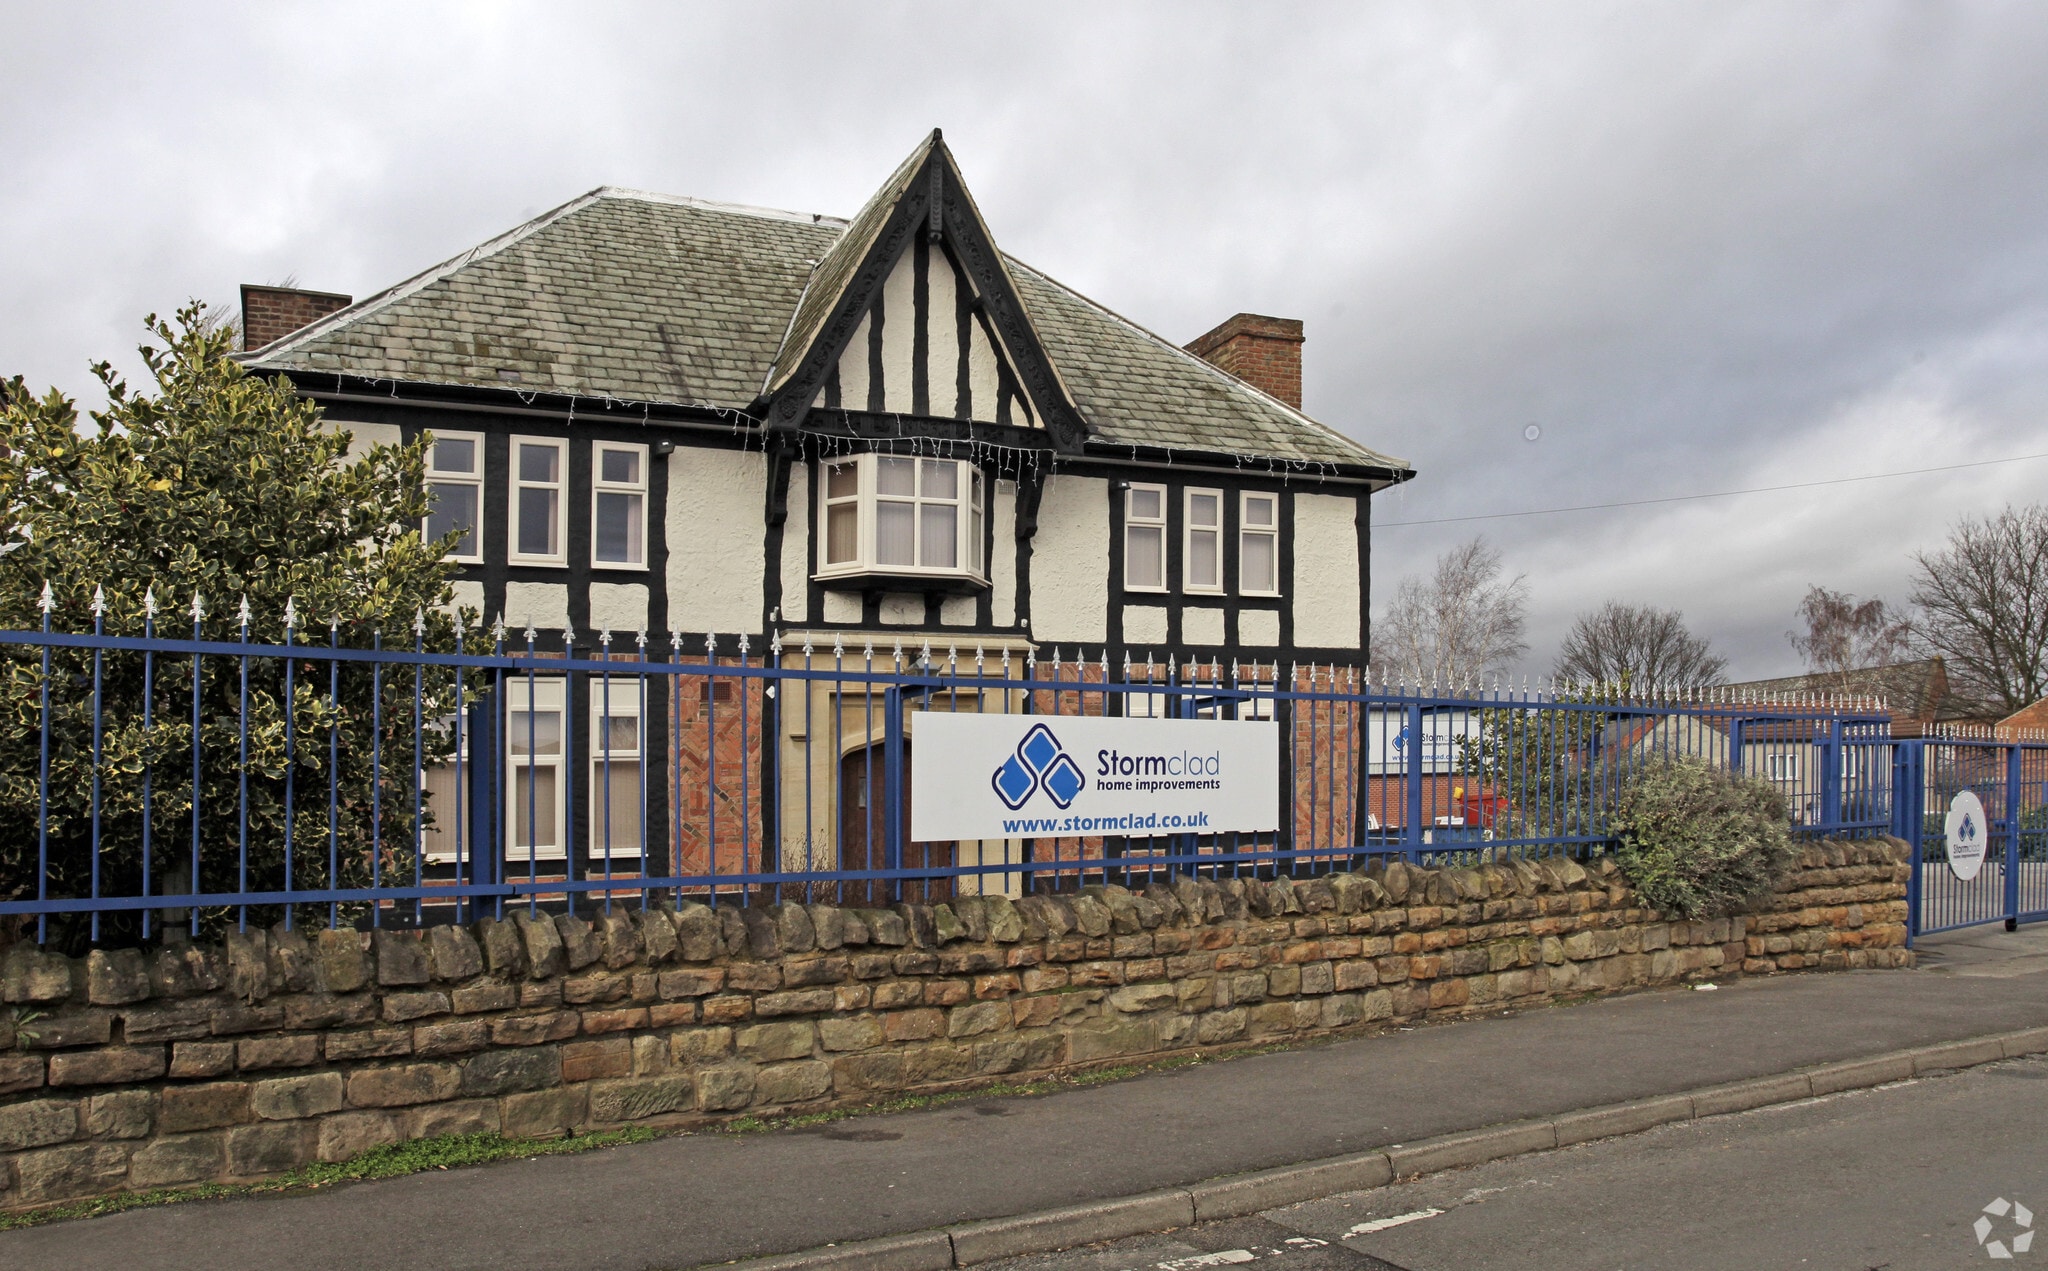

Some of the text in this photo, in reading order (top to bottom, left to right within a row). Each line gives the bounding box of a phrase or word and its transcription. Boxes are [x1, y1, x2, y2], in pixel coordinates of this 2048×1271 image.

[1097, 749, 1220, 776] Stormclad
[1096, 778, 1221, 794] home improvements
[1002, 811, 1209, 833] www.stormclad.co.uk
